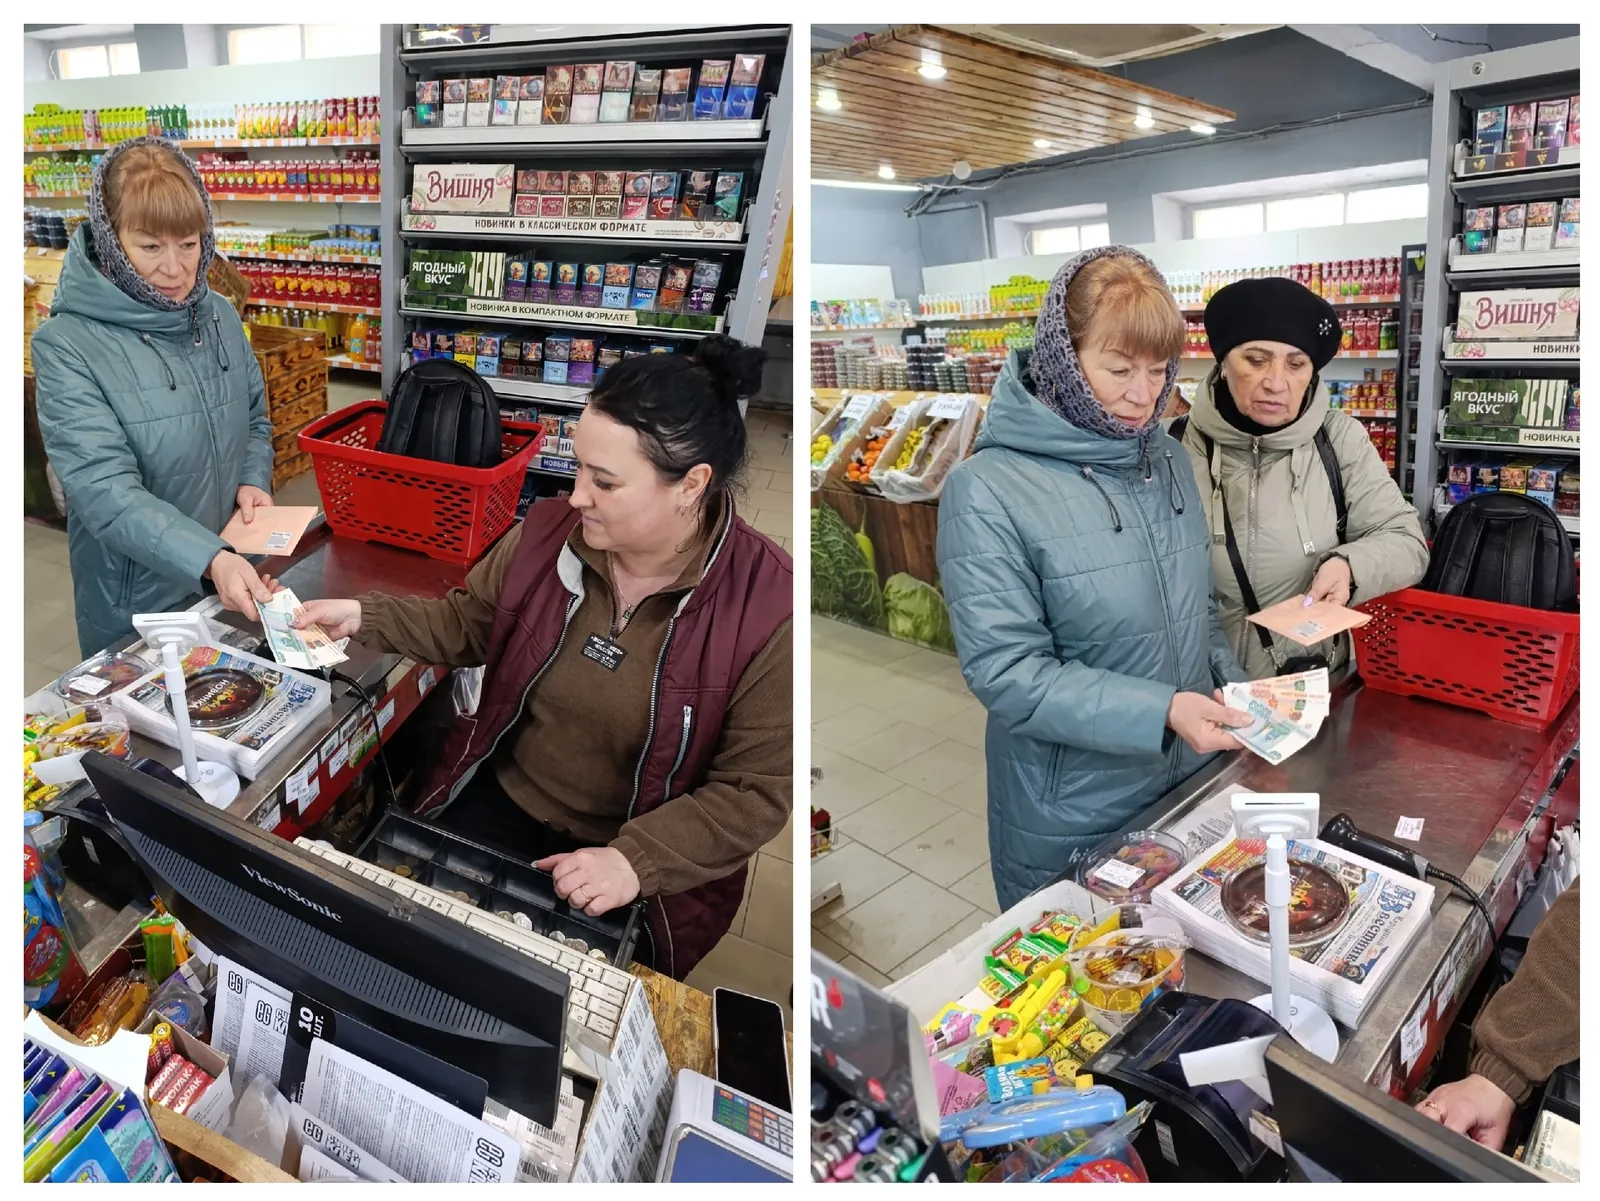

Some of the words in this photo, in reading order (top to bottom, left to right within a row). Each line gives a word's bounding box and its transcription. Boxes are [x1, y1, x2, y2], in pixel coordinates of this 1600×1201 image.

[427, 171, 495, 207] Вишня
[475, 219, 516, 228] НОВИНКИ
[520, 220, 525, 228] В
[528, 220, 597, 231] КЛАССИЧЕСКОМ
[599, 222, 647, 232] ФОРМАТЕ
[412, 261, 466, 274] ЯГОДНЫЙ
[470, 303, 510, 313] НОВИНКА
[519, 307, 583, 319] КОМПАКТНОМ
[585, 311, 631, 322] ФОРМАТЕ
[1474, 296, 1557, 331] Вишня
[1453, 389, 1519, 404] ЯГОДНЫЙ
[1523, 432, 1573, 443] НОВИНКА
[543, 459, 568, 469] НОВЫЙ
[188, 679, 229, 708] НОВИНКА
[240, 862, 343, 923] ViewSonic
[298, 1007, 313, 1033] 10
[150, 1061, 177, 1093] KODAK
[163, 1069, 190, 1105] KODAK
[997, 1066, 1013, 1099] ВОДНАЯ
[1006, 1070, 1025, 1089] ИГРА
[175, 1079, 202, 1112] KODAK
